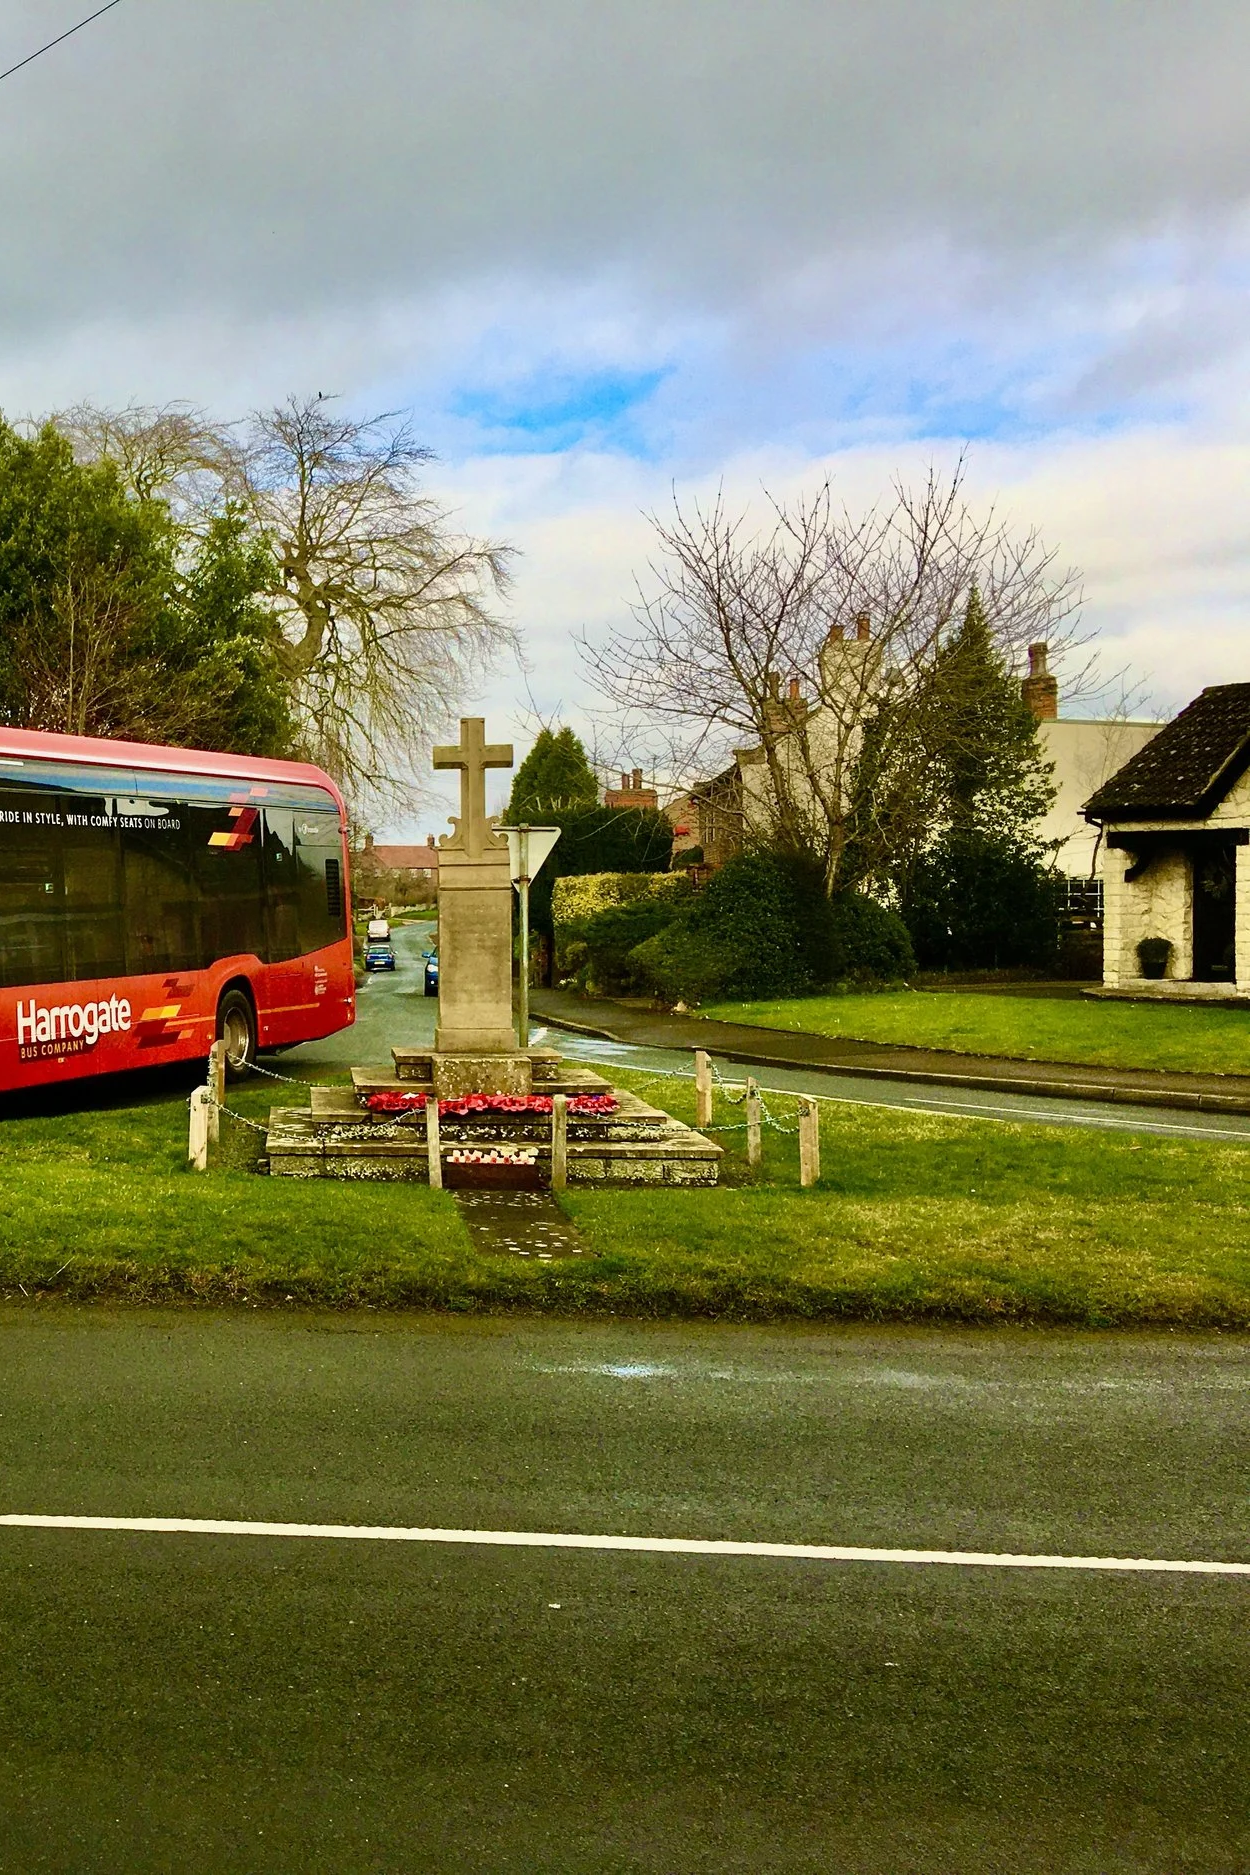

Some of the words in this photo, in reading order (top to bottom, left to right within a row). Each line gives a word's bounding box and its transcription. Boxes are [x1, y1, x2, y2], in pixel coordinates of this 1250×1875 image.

[22, 811, 33, 824] IN
[35, 812, 64, 827] STYLE,
[66, 814, 88, 826] WITH
[90, 815, 118, 827] COMFY
[119, 816, 143, 828] SEATS
[144, 818, 156, 829] ON
[157, 818, 181, 830] BOARD
[16, 992, 131, 1045] Harrogate
[20, 1045, 38, 1059] BUS
[41, 1039, 85, 1056] COMPANY
